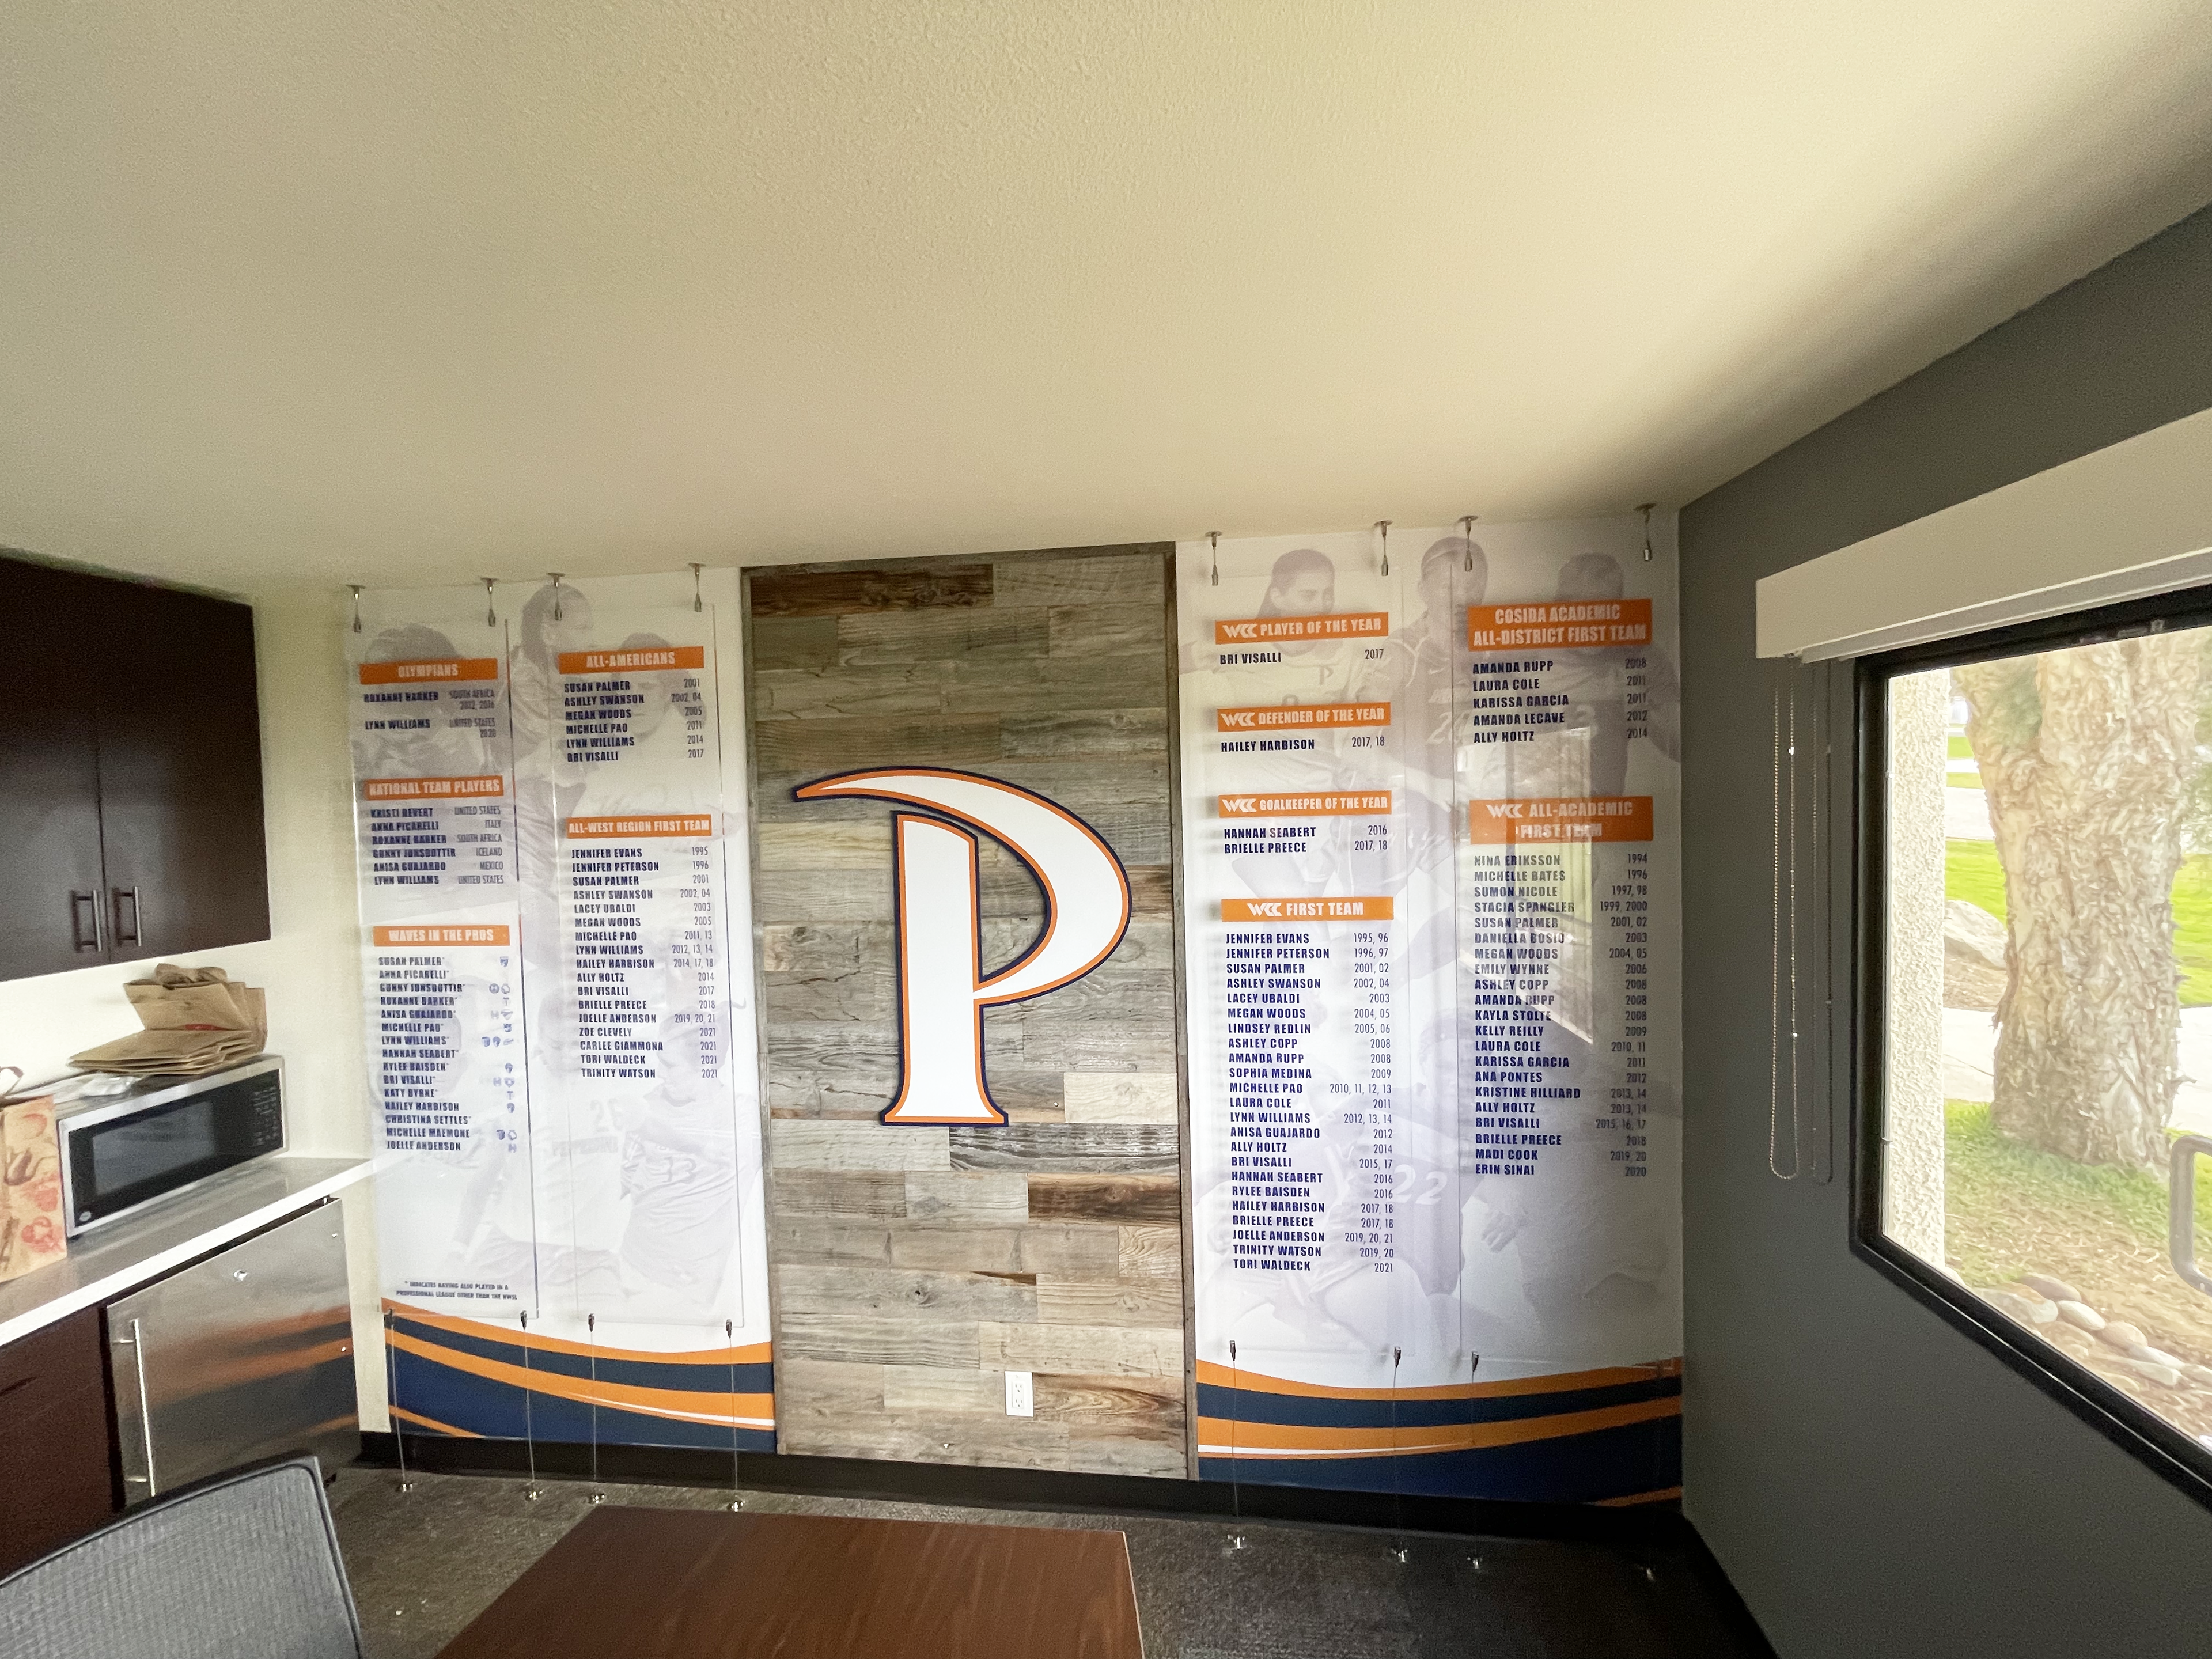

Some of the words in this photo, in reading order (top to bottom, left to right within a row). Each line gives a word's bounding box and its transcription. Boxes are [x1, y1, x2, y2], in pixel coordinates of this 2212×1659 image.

[1495, 608, 1546, 624] COSIDA
[1260, 622, 1303, 636] PLAYER
[1307, 621, 1321, 634] OF
[1324, 620, 1347, 632] THE
[1350, 618, 1381, 631] YEAR
[1474, 627, 1565, 646] ALL-DISTRICT
[1567, 626, 1607, 642] FIRST
[1609, 624, 1646, 641] TEAM
[586, 652, 675, 668] ALL-AMERICANS
[1220, 654, 1238, 664] BRI
[1241, 652, 1281, 664] VISALLI
[1365, 649, 1384, 660] 2017
[398, 664, 458, 678] OLYMPIANS
[564, 683, 593, 693] SUSAN
[596, 681, 630, 691] PALMER
[683, 679, 700, 688] 2001
[1473, 680, 1508, 691] LAURA
[1512, 679, 1540, 690] COLE
[1627, 676, 1646, 686] 2011
[1258, 711, 1313, 725] DEFENDER
[1316, 710, 1330, 722] OF
[1332, 709, 1354, 721] THE
[1356, 708, 1384, 720] YEAR
[1474, 714, 1520, 726] AMANDA
[1525, 713, 1565, 724] LECAVE
[1627, 710, 1647, 721] 2012
[566, 738, 588, 748] LYNN
[590, 737, 634, 747] WILLIAMS
[687, 735, 703, 744] 2014
[1474, 732, 1497, 743] ALLY
[1502, 730, 1535, 743] HOLTZ
[1627, 728, 1647, 738] 2014
[1221, 741, 1256, 752] HAILEY
[1260, 739, 1315, 751] HARBISON
[1351, 737, 1372, 748] 2017,
[1376, 736, 1385, 747] 18
[585, 751, 619, 762] VISALLI
[688, 749, 704, 759] 2017
[423, 781, 451, 794] TEAM
[454, 779, 500, 793] PLAYERS
[1260, 798, 1322, 811] GOALKEEPER
[1325, 797, 1338, 809] OF
[1340, 797, 1359, 809] THE
[1362, 797, 1388, 808] YEAR
[1529, 802, 1633, 817] ALL-ACADEMIC
[569, 821, 614, 834] ALL-WEST
[616, 821, 651, 832] REGION
[654, 820, 681, 831] FIRST
[684, 820, 710, 831] TEAM
[1224, 828, 1266, 839] HANNAH
[1270, 827, 1316, 838] SEABERT
[1368, 824, 1387, 835] 2016
[1520, 824, 1560, 838] FIRST
[1224, 843, 1264, 854] BRIELLE
[1268, 842, 1306, 853] PREECE
[1354, 840, 1374, 851] 2017,
[1378, 840, 1388, 850] 18
[572, 862, 612, 872] JENNIFER
[615, 862, 659, 872] PETERSON
[692, 861, 709, 870] 1996
[1474, 855, 1500, 866] NINA
[1505, 855, 1560, 866] ERIKSSON
[1628, 854, 1647, 863] 1994
[574, 904, 600, 914] LACEY
[603, 904, 635, 913] UBALDI
[694, 903, 711, 912] 2003
[1286, 903, 1324, 916] FIRST
[1328, 902, 1363, 915] TEAM
[1475, 902, 1514, 912] STACIA
[1518, 902, 1574, 912] SPANGLER
[1626, 901, 1647, 911] 2000
[389, 930, 425, 942] WAVES
[429, 930, 440, 941] IN
[443, 930, 463, 941] THE
[1226, 934, 1272, 944] JENNIFER
[1276, 933, 1309, 944] EVANS
[1354, 933, 1375, 944] 1995,
[1378, 933, 1388, 942] 96
[575, 945, 597, 955] LYNN
[599, 945, 643, 955] WILLIAMS
[672, 945, 690, 955] 2012,
[693, 944, 702, 954] 13,
[705, 944, 713, 953] 14
[791, 766, 1132, 1127] P
[1475, 964, 1507, 975] EMILY
[1510, 964, 1549, 975] WYNNE
[1626, 964, 1647, 974] 2006
[1227, 979, 1264, 988] ASHLEY
[1268, 979, 1320, 988] SWANSON
[1354, 978, 1376, 989] 2002,
[1379, 978, 1389, 988] 04
[578, 1000, 612, 1009] BRIELLE
[615, 1001, 646, 1009] PREECE
[699, 1000, 715, 1009] 2018
[579, 1028, 595, 1036] ZOE
[598, 1028, 632, 1037] CLEVELY
[699, 1028, 715, 1037] 2021
[1228, 1023, 1270, 1033] LINDSEY
[1274, 1024, 1310, 1034] REDLIN
[1354, 1024, 1377, 1034] 2005,
[1380, 1024, 1390, 1033] 06
[1475, 1025, 1505, 1036] KELLY
[1509, 1026, 1544, 1036] REILLY
[1626, 1026, 1647, 1036] 2009
[581, 1069, 616, 1078] TRINITY
[618, 1069, 656, 1078] WATSON
[702, 1069, 718, 1078] 2021
[1229, 1068, 1268, 1078] SOPHIA
[1271, 1069, 1312, 1078] MEDINA
[1371, 1069, 1391, 1079] 2009
[1475, 1071, 1497, 1082] ANA
[1500, 1071, 1543, 1082] PONTES
[1627, 1073, 1646, 1083] 2012
[1229, 1082, 1279, 1093] MICHELLE
[1283, 1084, 1302, 1093] PAO
[1330, 1084, 1351, 1094] 2010,
[1355, 1084, 1364, 1094] 11,
[1368, 1084, 1379, 1094] 12,
[1383, 1084, 1391, 1094] 13
[1475, 1086, 1527, 1097] KRISTINE
[1530, 1088, 1581, 1099] HILLIARD
[1230, 1127, 1262, 1137] ANISA
[1266, 1127, 1320, 1138] GUAJARDO
[1373, 1129, 1392, 1139] 2012
[1476, 1164, 1500, 1175] ERIN
[1504, 1165, 1535, 1175] SINAI
[1232, 1186, 1262, 1196] RYLEE
[1265, 1187, 1309, 1197] BAISDEN
[1374, 1189, 1393, 1199] 2016
[1233, 1259, 1257, 1269] TORI
[1261, 1260, 1310, 1271] WALDECK
[1374, 1263, 1393, 1272] 2021
